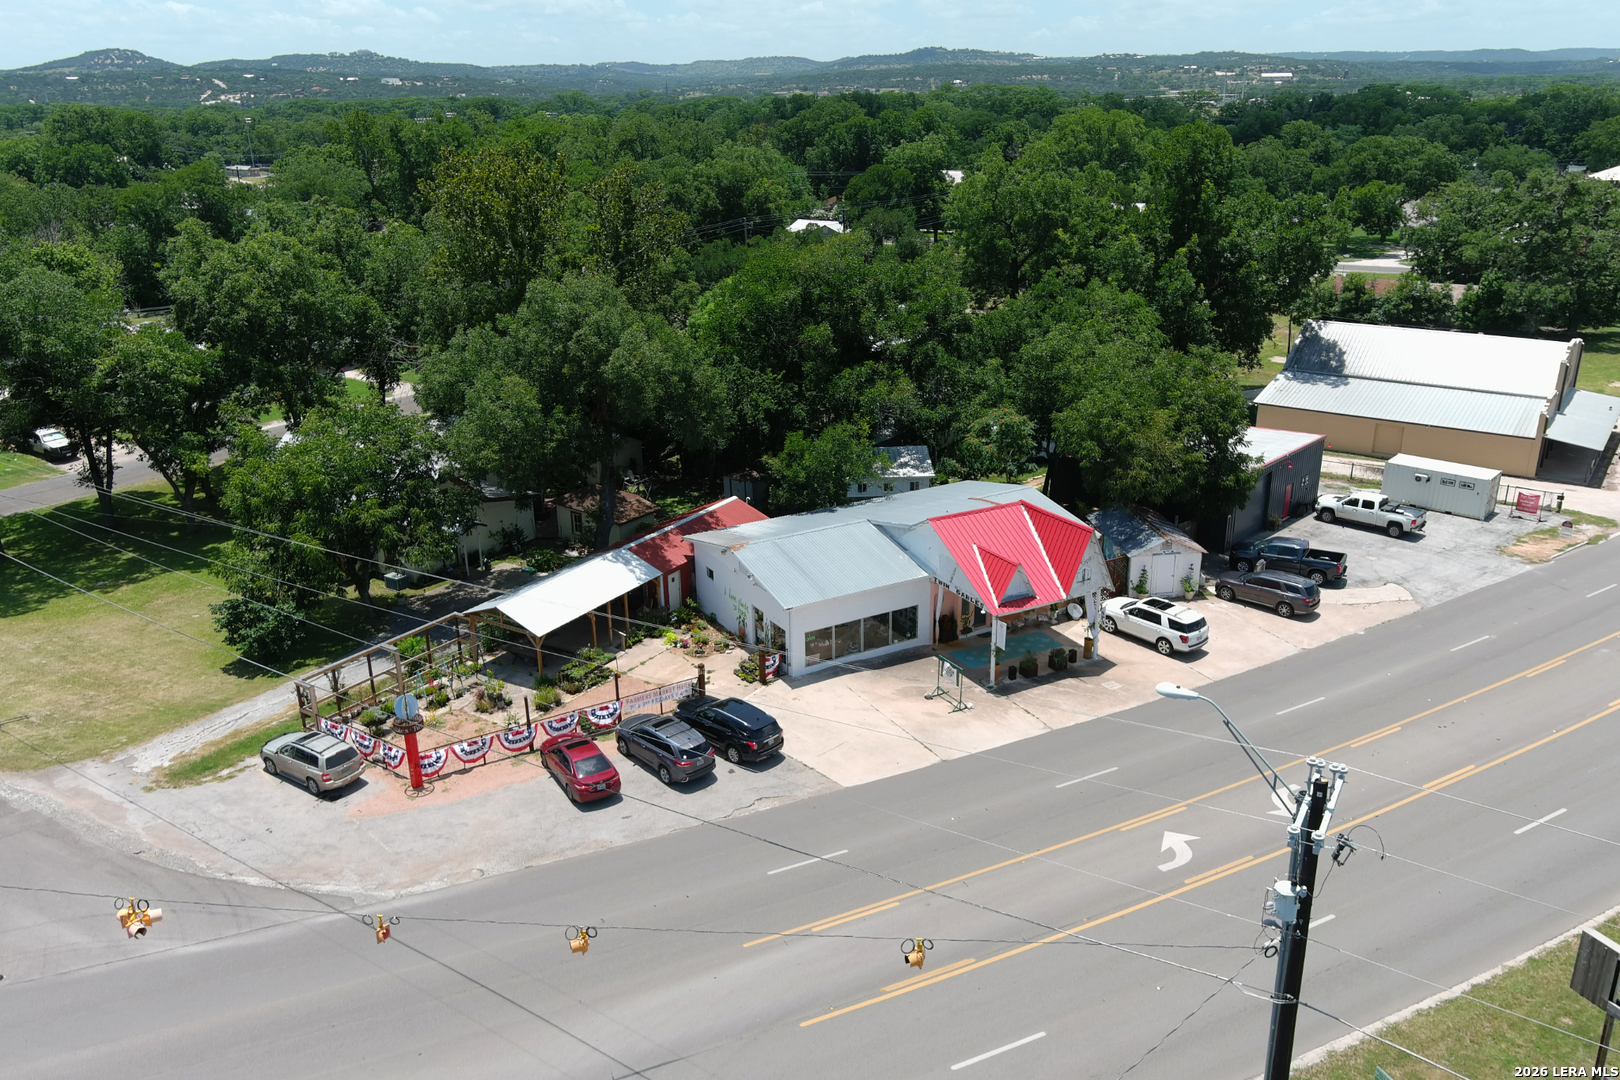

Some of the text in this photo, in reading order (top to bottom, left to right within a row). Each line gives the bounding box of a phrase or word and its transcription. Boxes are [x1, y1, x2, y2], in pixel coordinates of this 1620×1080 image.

[933, 576, 950, 590] TWIN
[625, 693, 652, 705] FARMERS
[652, 687, 675, 698] MARKET
